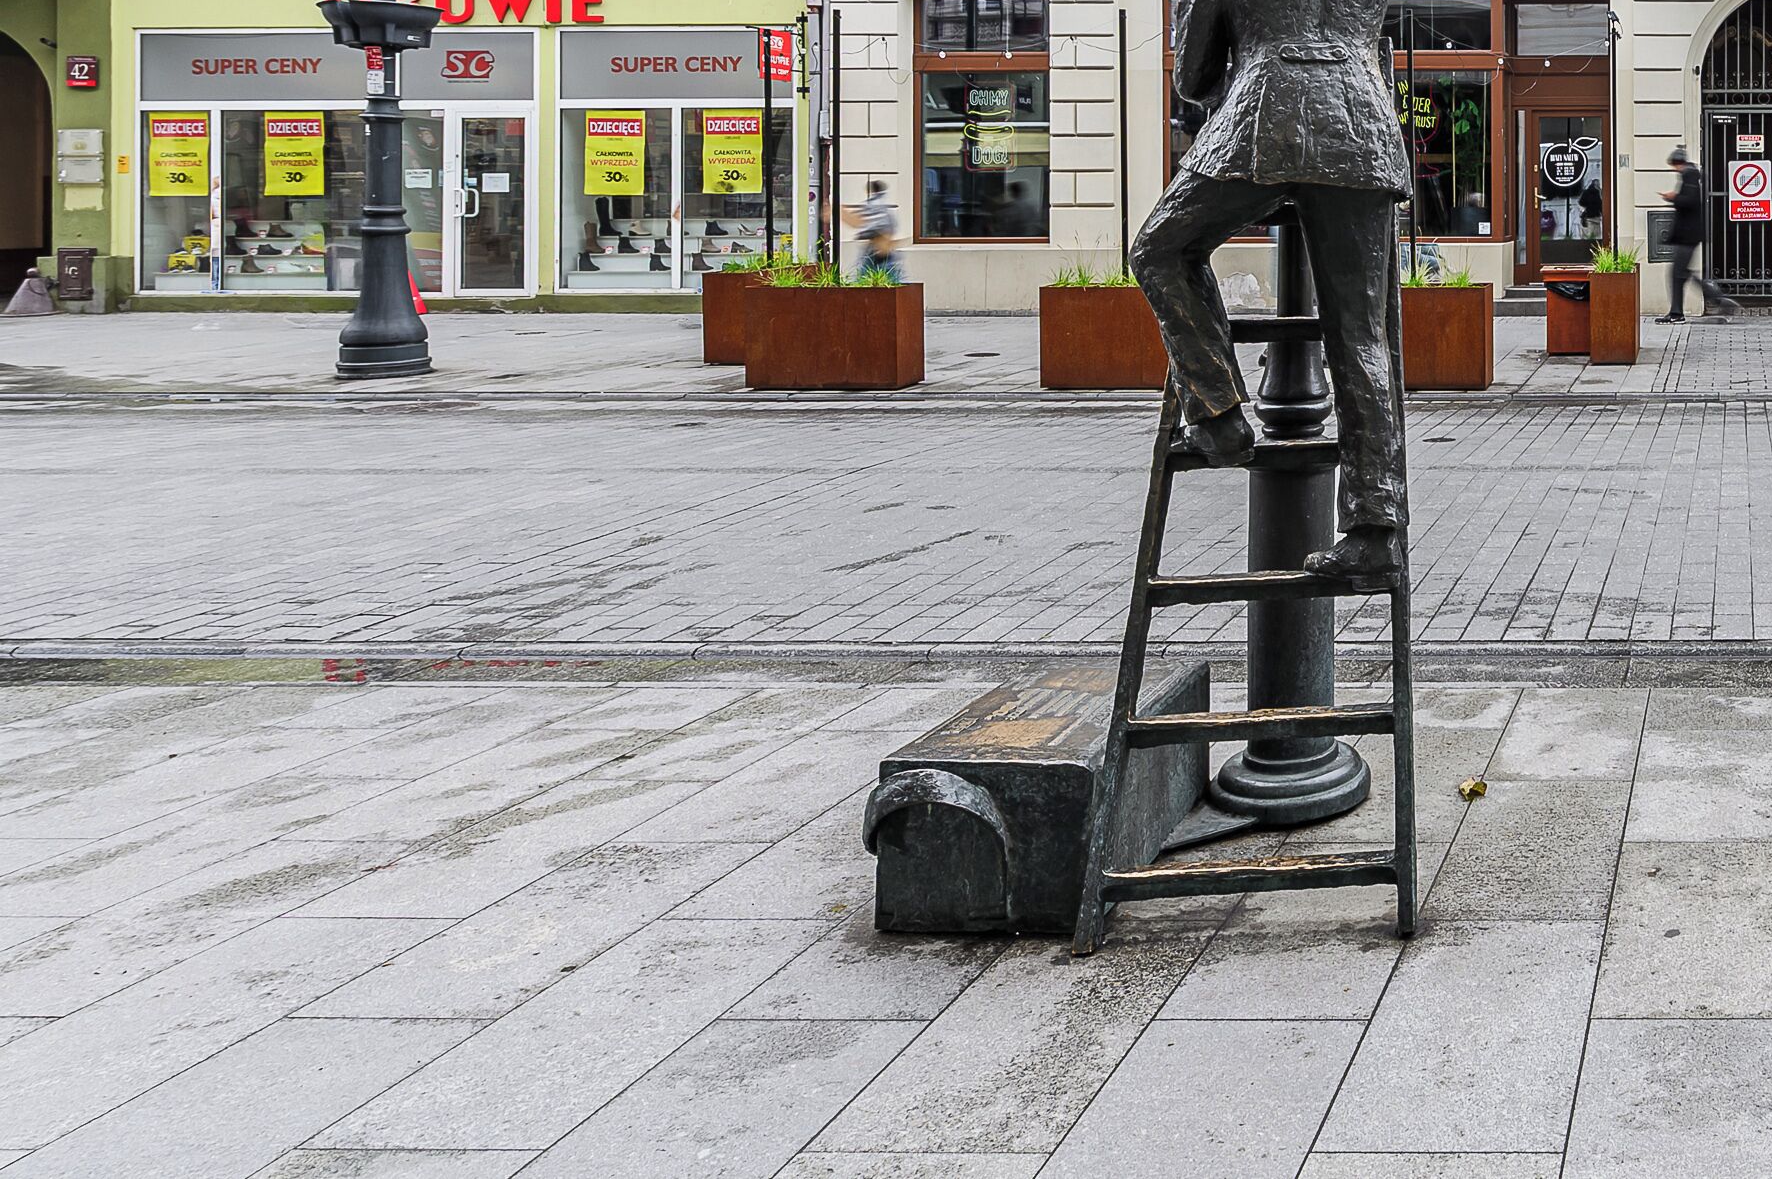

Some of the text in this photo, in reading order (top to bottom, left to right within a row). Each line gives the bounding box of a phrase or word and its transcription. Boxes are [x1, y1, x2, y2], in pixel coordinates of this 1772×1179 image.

[70, 63, 90, 80] 42
[191, 57, 322, 75] SUPER CENY
[441, 51, 495, 78] SC
[610, 56, 743, 73] SUPER CENY
[1397, 79, 1409, 94] IN
[1402, 94, 1431, 113] CDER
[153, 122, 205, 136] DZIECIĘCE
[268, 122, 321, 136] DZIECIĘCE
[589, 121, 641, 136] DZIECIĘCE
[707, 119, 757, 133] DZIECIĘCE
[590, 158, 639, 166] WYPRZEDAŻ
[708, 157, 756, 165] WYPRZEDAŻ
[972, 145, 1009, 164] DOG!
[602, 171, 630, 183] -30%
[719, 169, 747, 181] -30%
